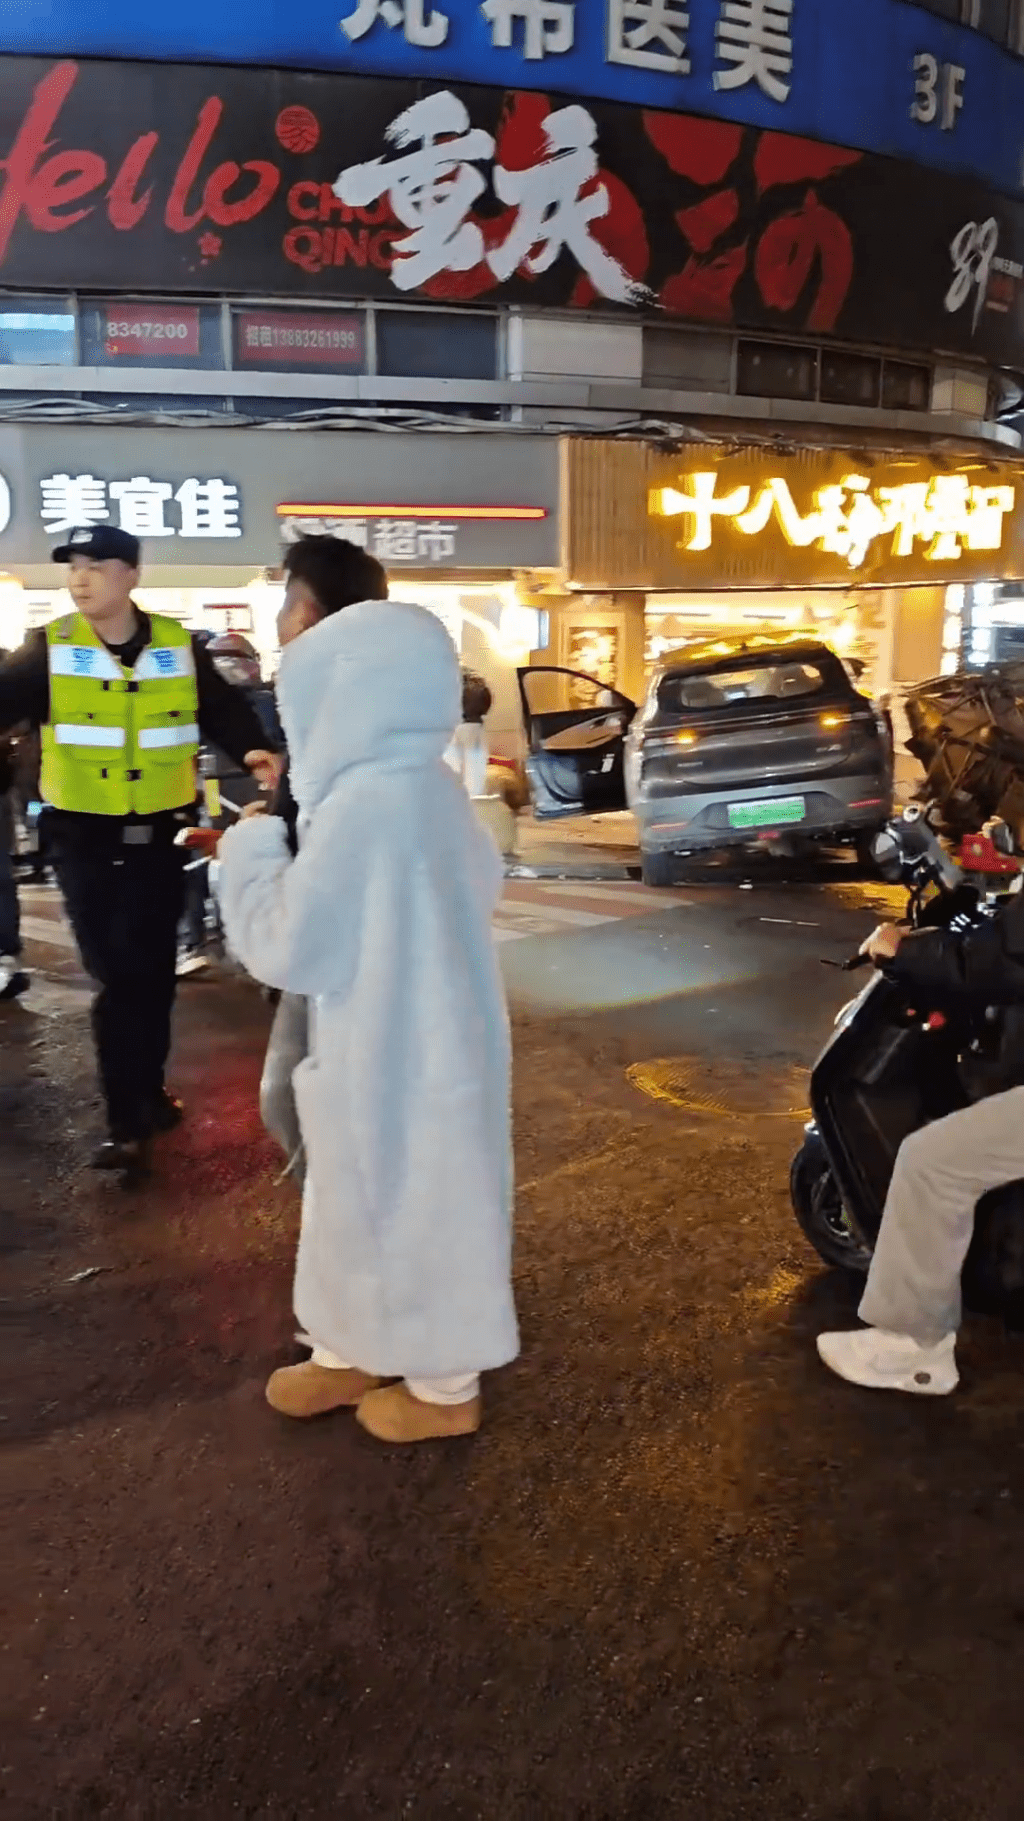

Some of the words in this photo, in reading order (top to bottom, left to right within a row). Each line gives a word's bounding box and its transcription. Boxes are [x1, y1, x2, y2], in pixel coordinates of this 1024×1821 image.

[910, 52, 966, 130] 3F
[106, 321, 188, 338] 8347200
[40, 473, 242, 538] 美宜佳
